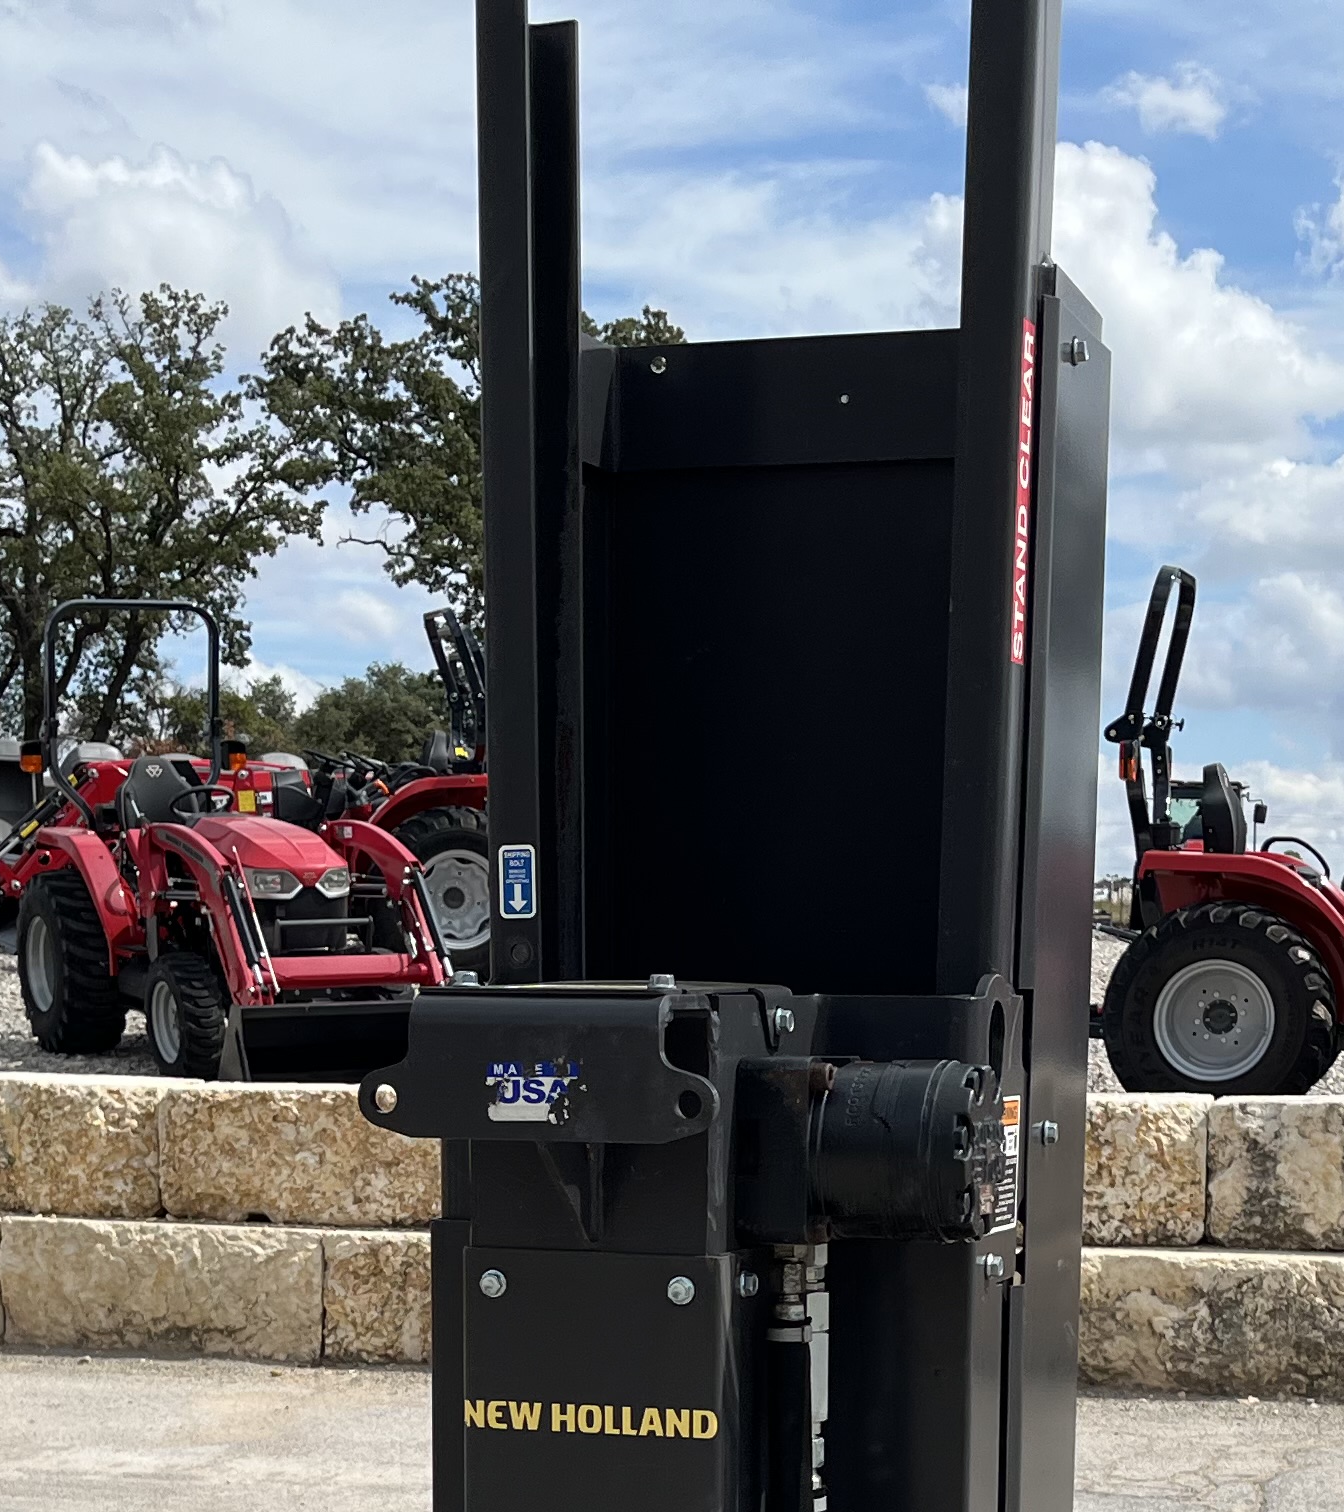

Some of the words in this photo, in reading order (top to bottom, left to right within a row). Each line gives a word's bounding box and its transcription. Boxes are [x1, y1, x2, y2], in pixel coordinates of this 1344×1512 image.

[1019, 331, 1035, 490] CLEAR
[1012, 504, 1028, 660] STAND
[493, 1063, 543, 1075] MAE
[496, 1078, 569, 1104] USA
[464, 1399, 543, 1431] NEW
[551, 1402, 719, 1440] HOLLAND
